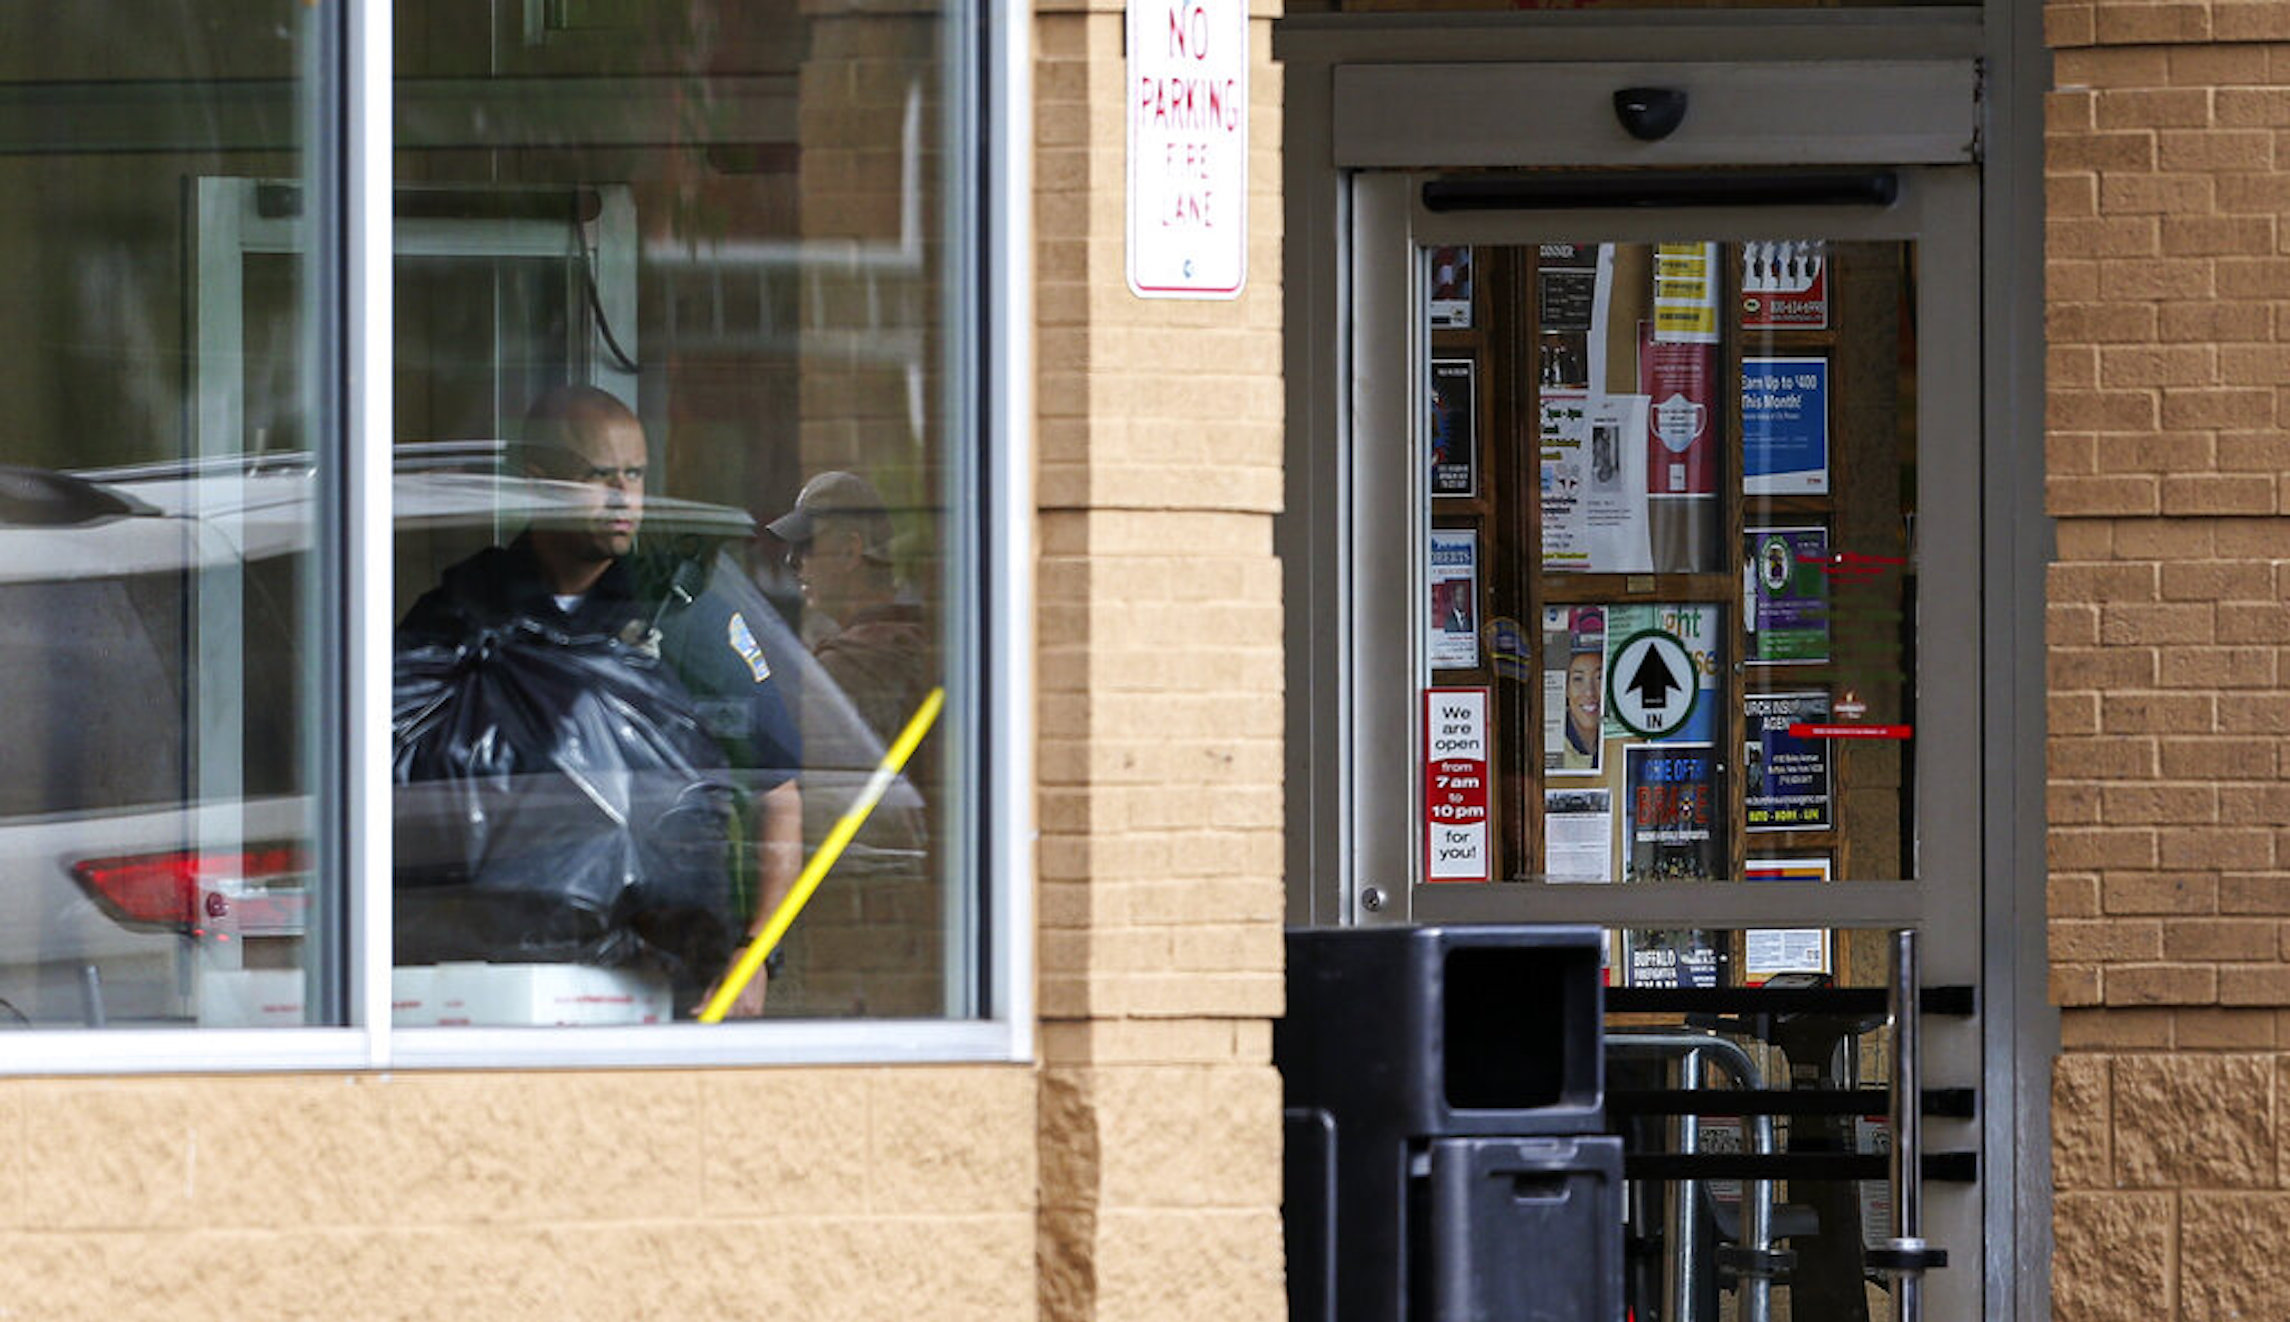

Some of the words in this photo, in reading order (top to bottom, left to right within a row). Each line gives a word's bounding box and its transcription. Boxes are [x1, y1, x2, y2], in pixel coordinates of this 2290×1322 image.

[1168, 6, 1208, 60] NO
[1141, 76, 1239, 132] PARKING
[1166, 142, 1209, 180] FRE
[1162, 191, 1213, 228] LANE
[1741, 374, 1763, 390] Earn
[1764, 374, 1780, 392] Up
[1781, 376, 1794, 390] to
[1741, 394, 1762, 409] This
[1443, 706, 1471, 719] We
[1646, 713, 1662, 728] IN
[1442, 723, 1471, 735] are
[1435, 739, 1479, 752] open
[1441, 762, 1473, 772] from
[1448, 793, 1464, 803] to
[1637, 785, 1709, 826] BRAE
[1446, 831, 1470, 843] for
[1440, 846, 1476, 861] you!
[1634, 949, 1676, 967] BUFFALO
